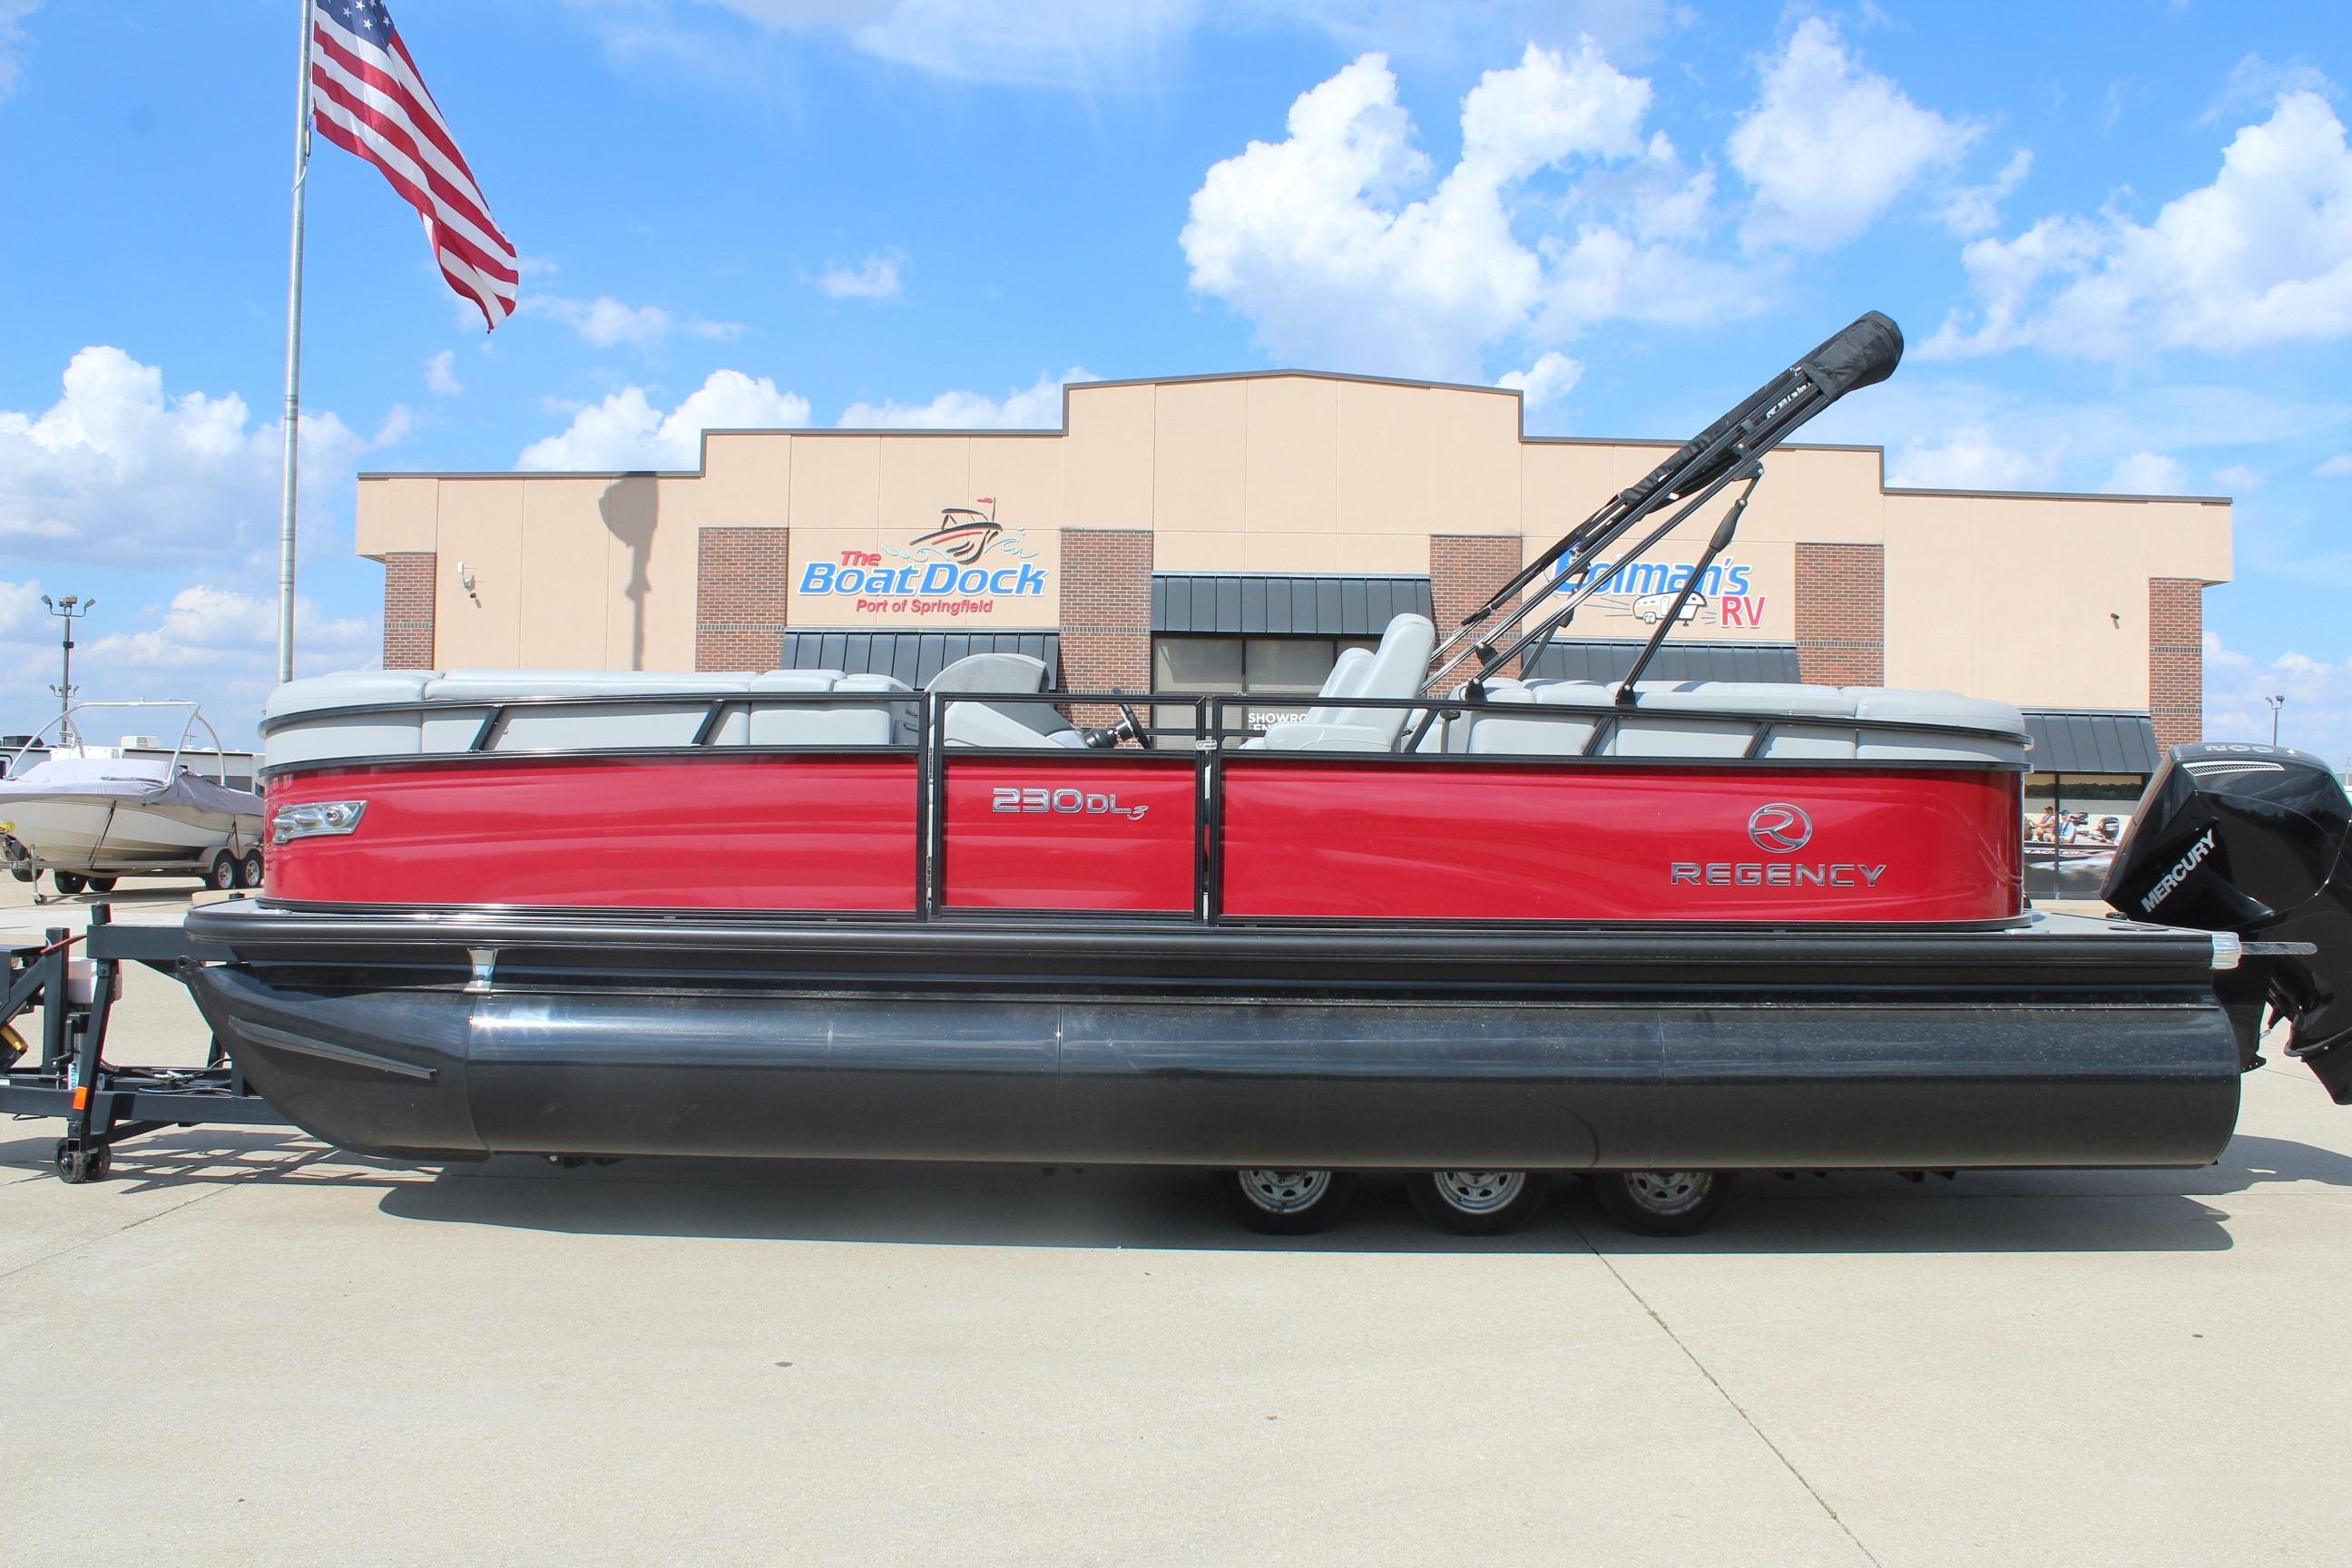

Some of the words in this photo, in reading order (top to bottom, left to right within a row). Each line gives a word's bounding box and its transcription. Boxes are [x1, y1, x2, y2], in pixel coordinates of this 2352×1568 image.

[841, 551, 881, 566] The
[856, 599, 887, 612] Port
[892, 599, 907, 612] of
[910, 599, 994, 616] Springfield
[1720, 596, 1766, 629] RV
[1248, 713, 1308, 723] SHOWRO
[1671, 862, 1886, 887] REGENCY
[2141, 828, 2217, 913] MERCURY
